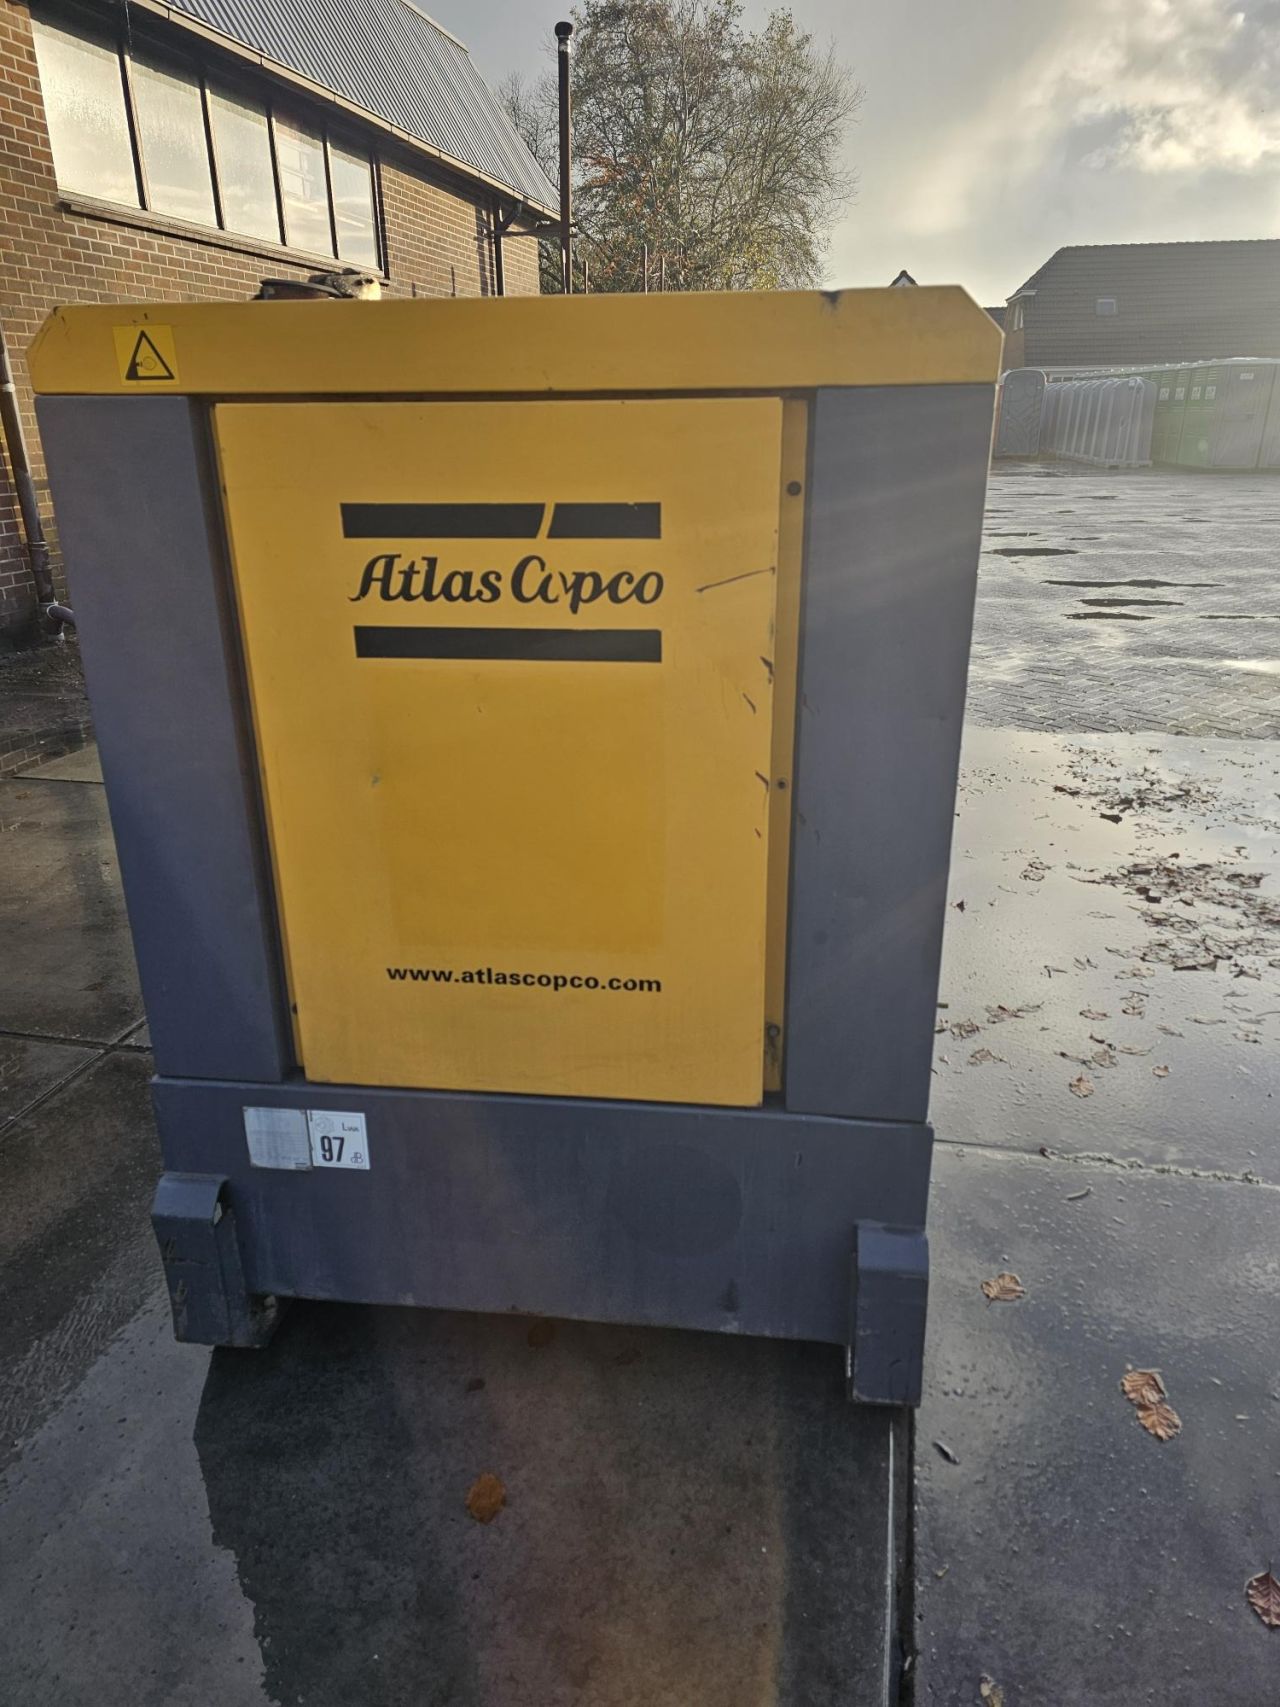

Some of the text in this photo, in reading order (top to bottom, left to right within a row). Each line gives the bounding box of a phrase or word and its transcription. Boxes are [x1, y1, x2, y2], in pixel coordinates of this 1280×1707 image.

[347, 553, 502, 602] Atlas
[386, 967, 662, 992] www.atlascopco.com
[320, 1135, 345, 1162] 97
